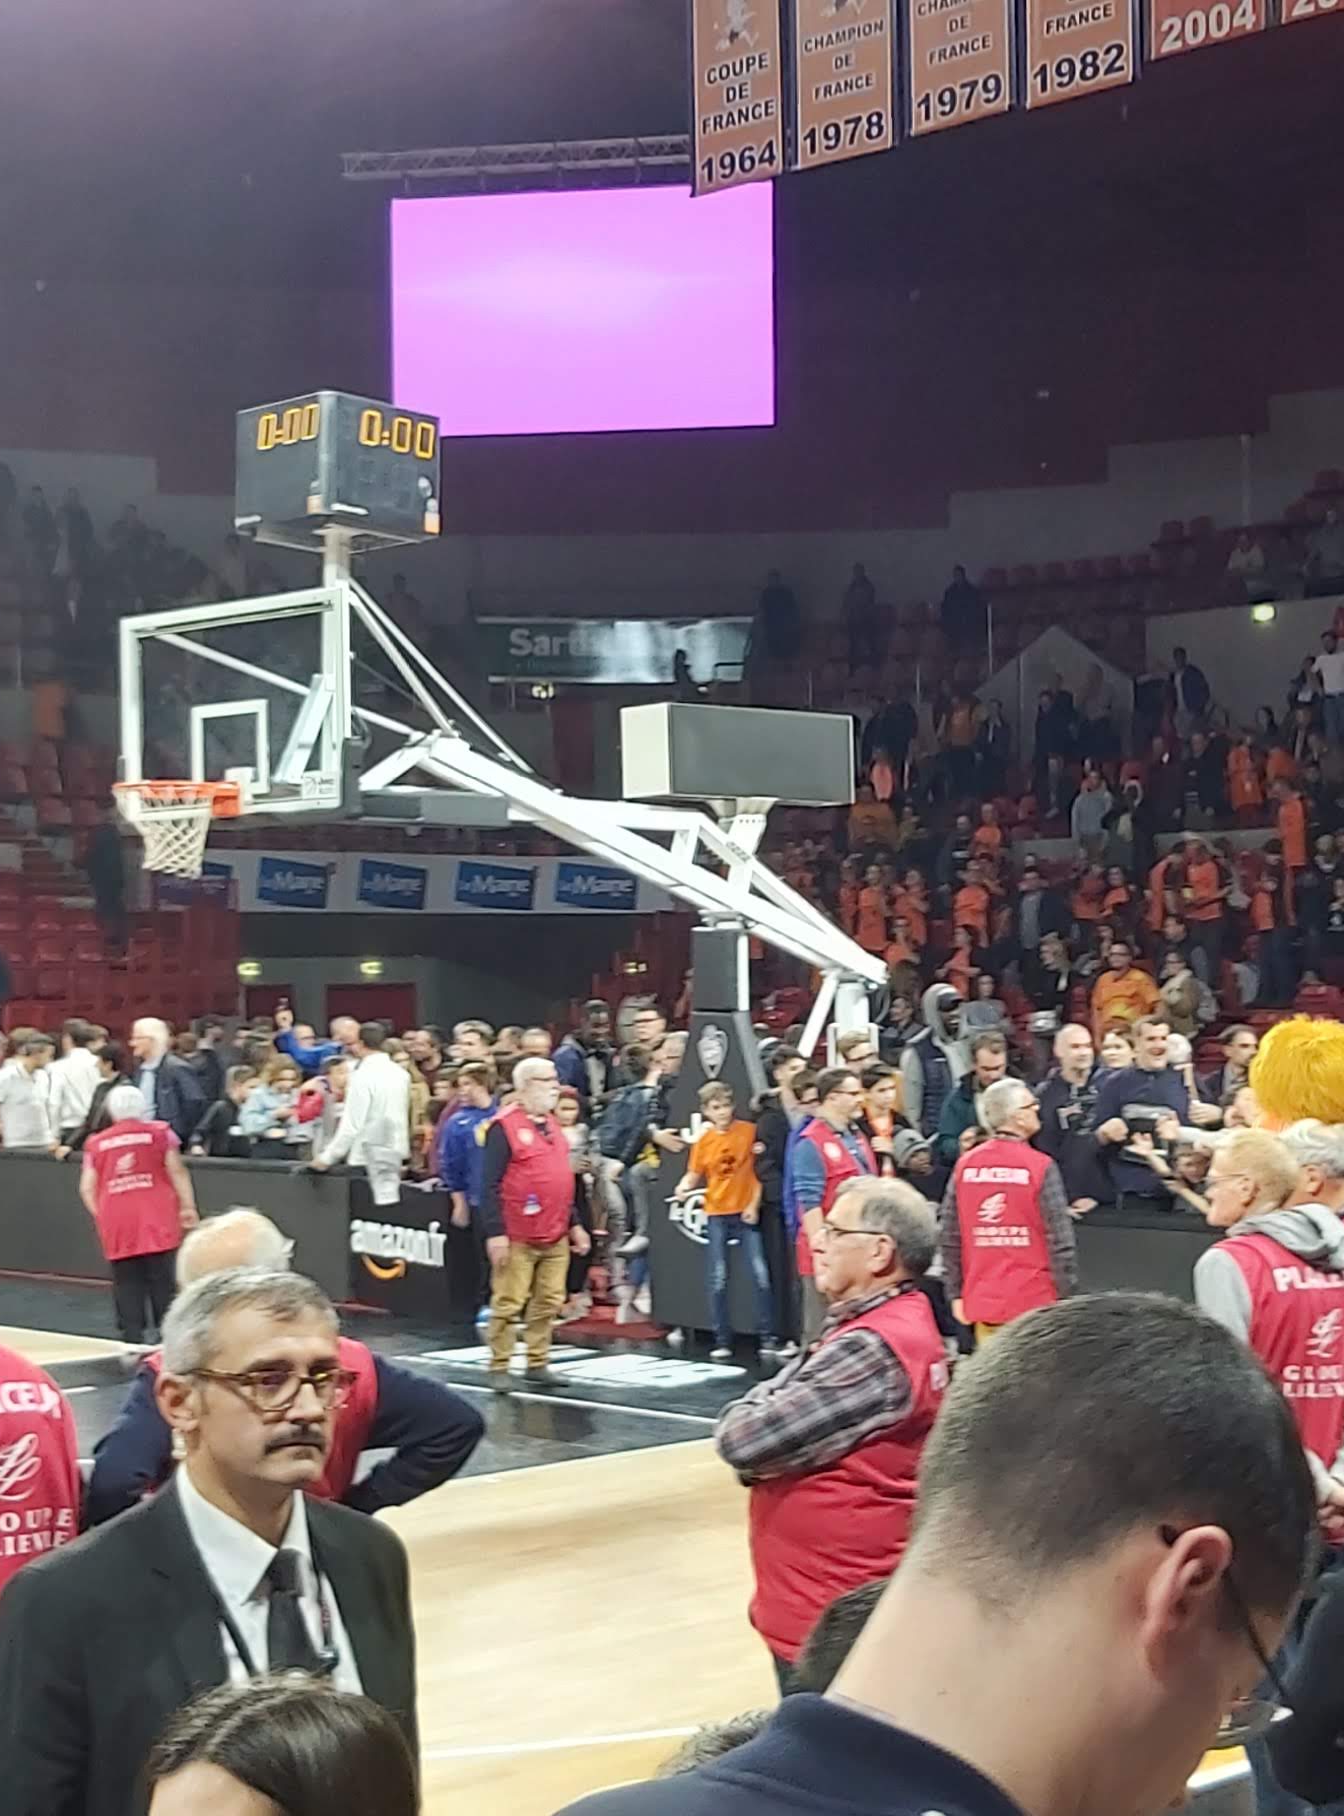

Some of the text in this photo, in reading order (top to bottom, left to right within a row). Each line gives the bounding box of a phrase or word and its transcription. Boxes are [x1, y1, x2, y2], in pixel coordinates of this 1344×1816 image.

[805, 20, 884, 52] CHAMPION
[948, 16, 969, 33] DE
[1045, 4, 1113, 35] FRANCE
[1160, 0, 1256, 53] 2004
[834, 54, 853, 70] DE
[928, 35, 991, 64] FRANCE
[706, 52, 769, 84] COUPE
[1033, 43, 1126, 94] 1982
[725, 82, 749, 104] DE
[814, 73, 874, 100] FRANCE
[916, 73, 1003, 121] 1979
[702, 100, 775, 135] FRANCE
[803, 111, 885, 155] 1978
[701, 139, 777, 183] 1964
[257, 403, 320, 450] 0:00
[359, 409, 436, 459] 0:00
